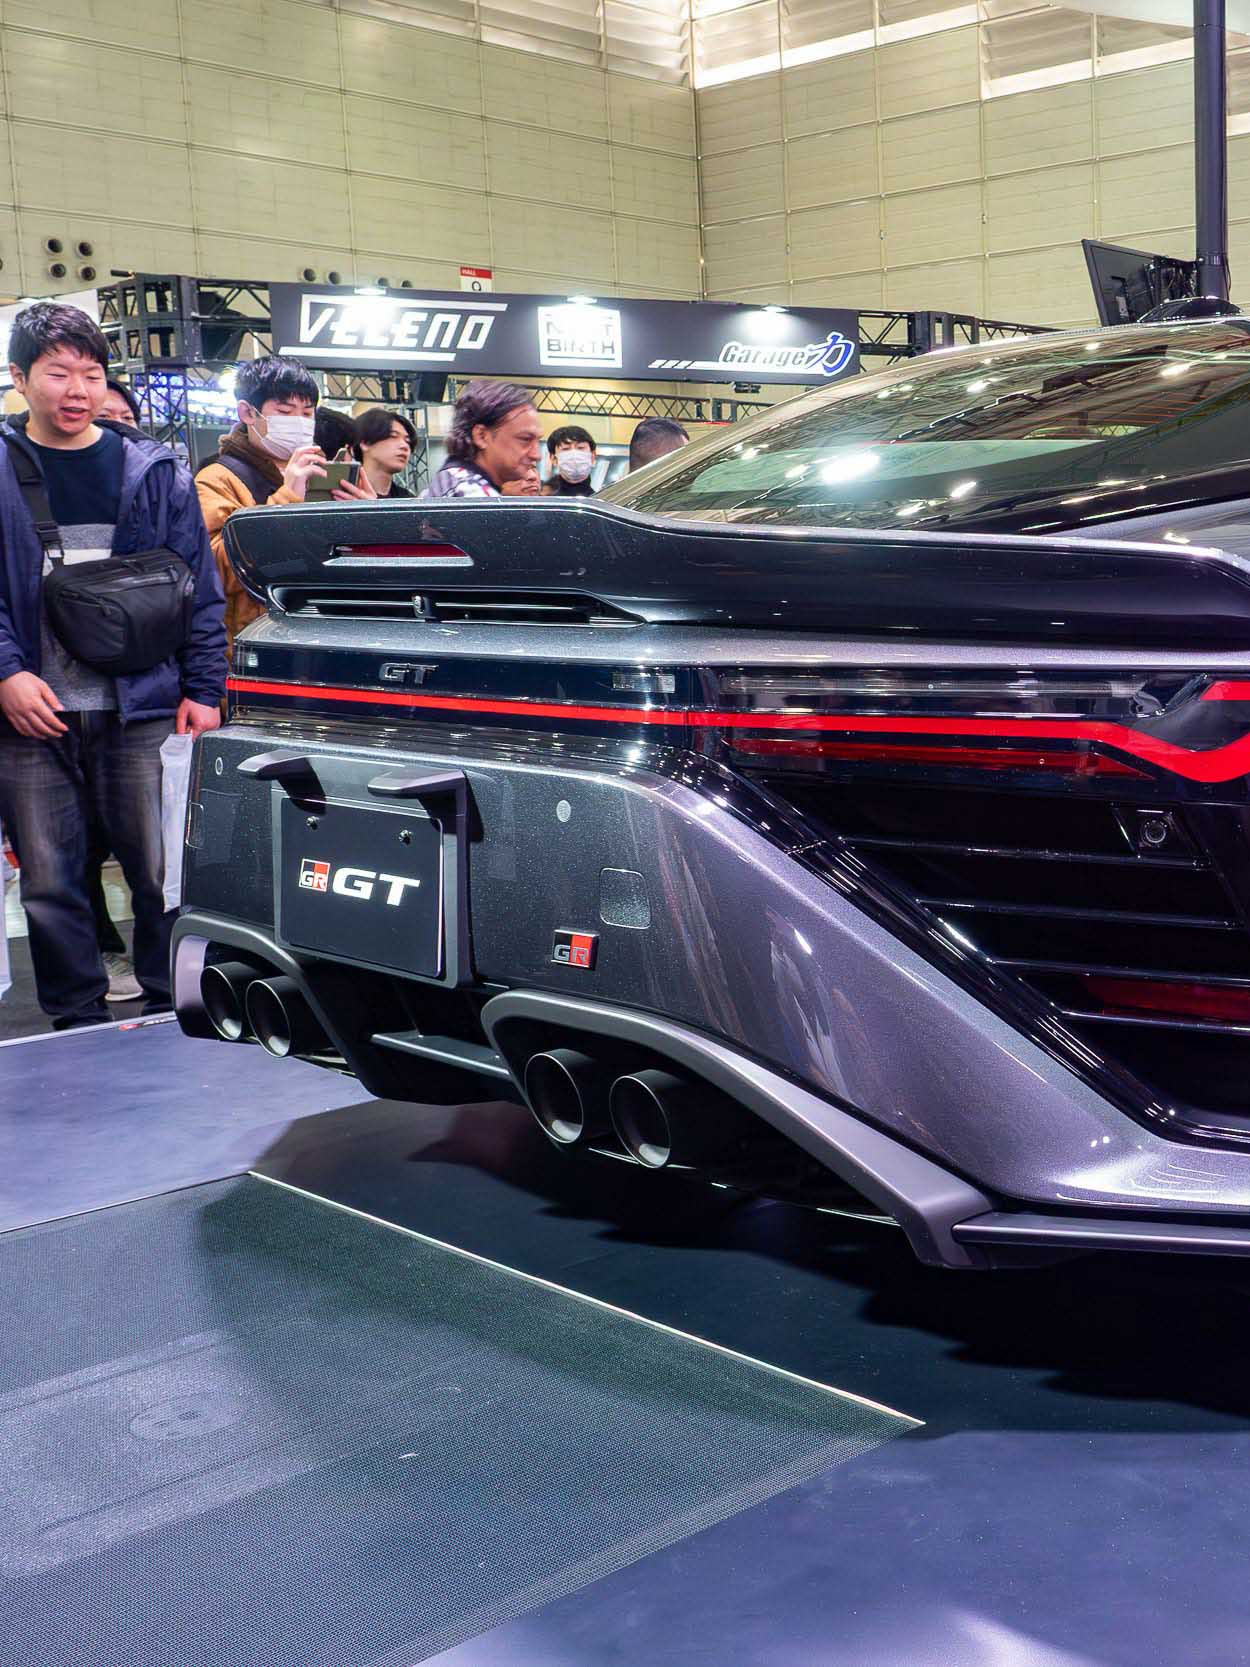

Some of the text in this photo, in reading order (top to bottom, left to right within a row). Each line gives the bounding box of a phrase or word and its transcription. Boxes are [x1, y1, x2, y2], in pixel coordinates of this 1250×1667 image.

[379, 663, 439, 684] GT
[301, 867, 420, 906] GR GT
[553, 942, 590, 966] GR
